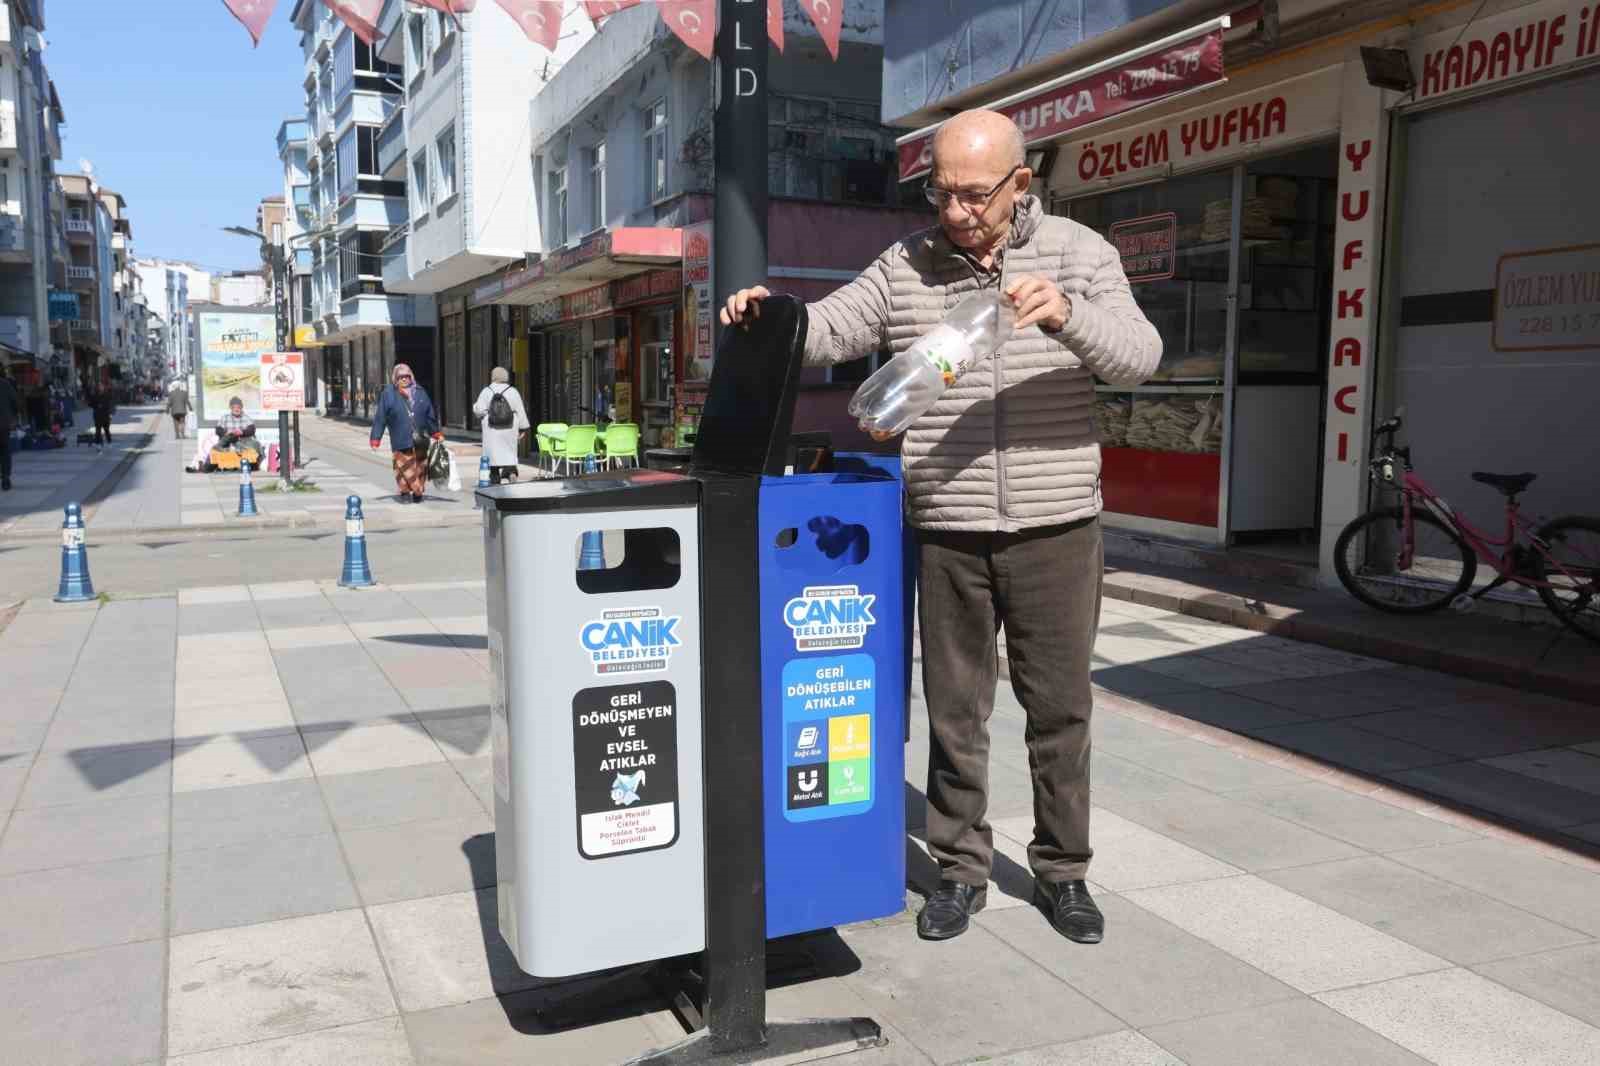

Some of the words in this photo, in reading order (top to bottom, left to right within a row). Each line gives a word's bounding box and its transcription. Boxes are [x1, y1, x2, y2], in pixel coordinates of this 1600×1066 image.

[735, 0, 758, 97] LD
[1422, 14, 1567, 97] KADAYIF
[1013, 89, 1096, 133] UFKA
[1105, 74, 1128, 99] Tel:
[1183, 50, 1200, 76] 75
[1078, 129, 1169, 182] ÖZLEM
[1181, 96, 1287, 156] YUFKA
[1504, 274, 1561, 308] ÖZLEM
[1568, 271, 1600, 304] YU
[1334, 139, 1371, 461] YUFKACI
[1519, 317, 1552, 334] 228
[1561, 313, 1583, 333] 15
[795, 624, 864, 637] BELEDİYESİ
[593, 646, 669, 661] BELEDİYESİ
[815, 664, 844, 679] GERİ
[787, 678, 871, 697] DÖNÜŞEBİLEN
[610, 690, 642, 707] GERİ
[804, 695, 856, 711] ATIKLAR
[579, 705, 672, 727] DÖNÜŞMEYEN
[618, 725, 636, 737] VE
[607, 739, 648, 755] EVSEL
[599, 753, 656, 772] ATIKLAR
